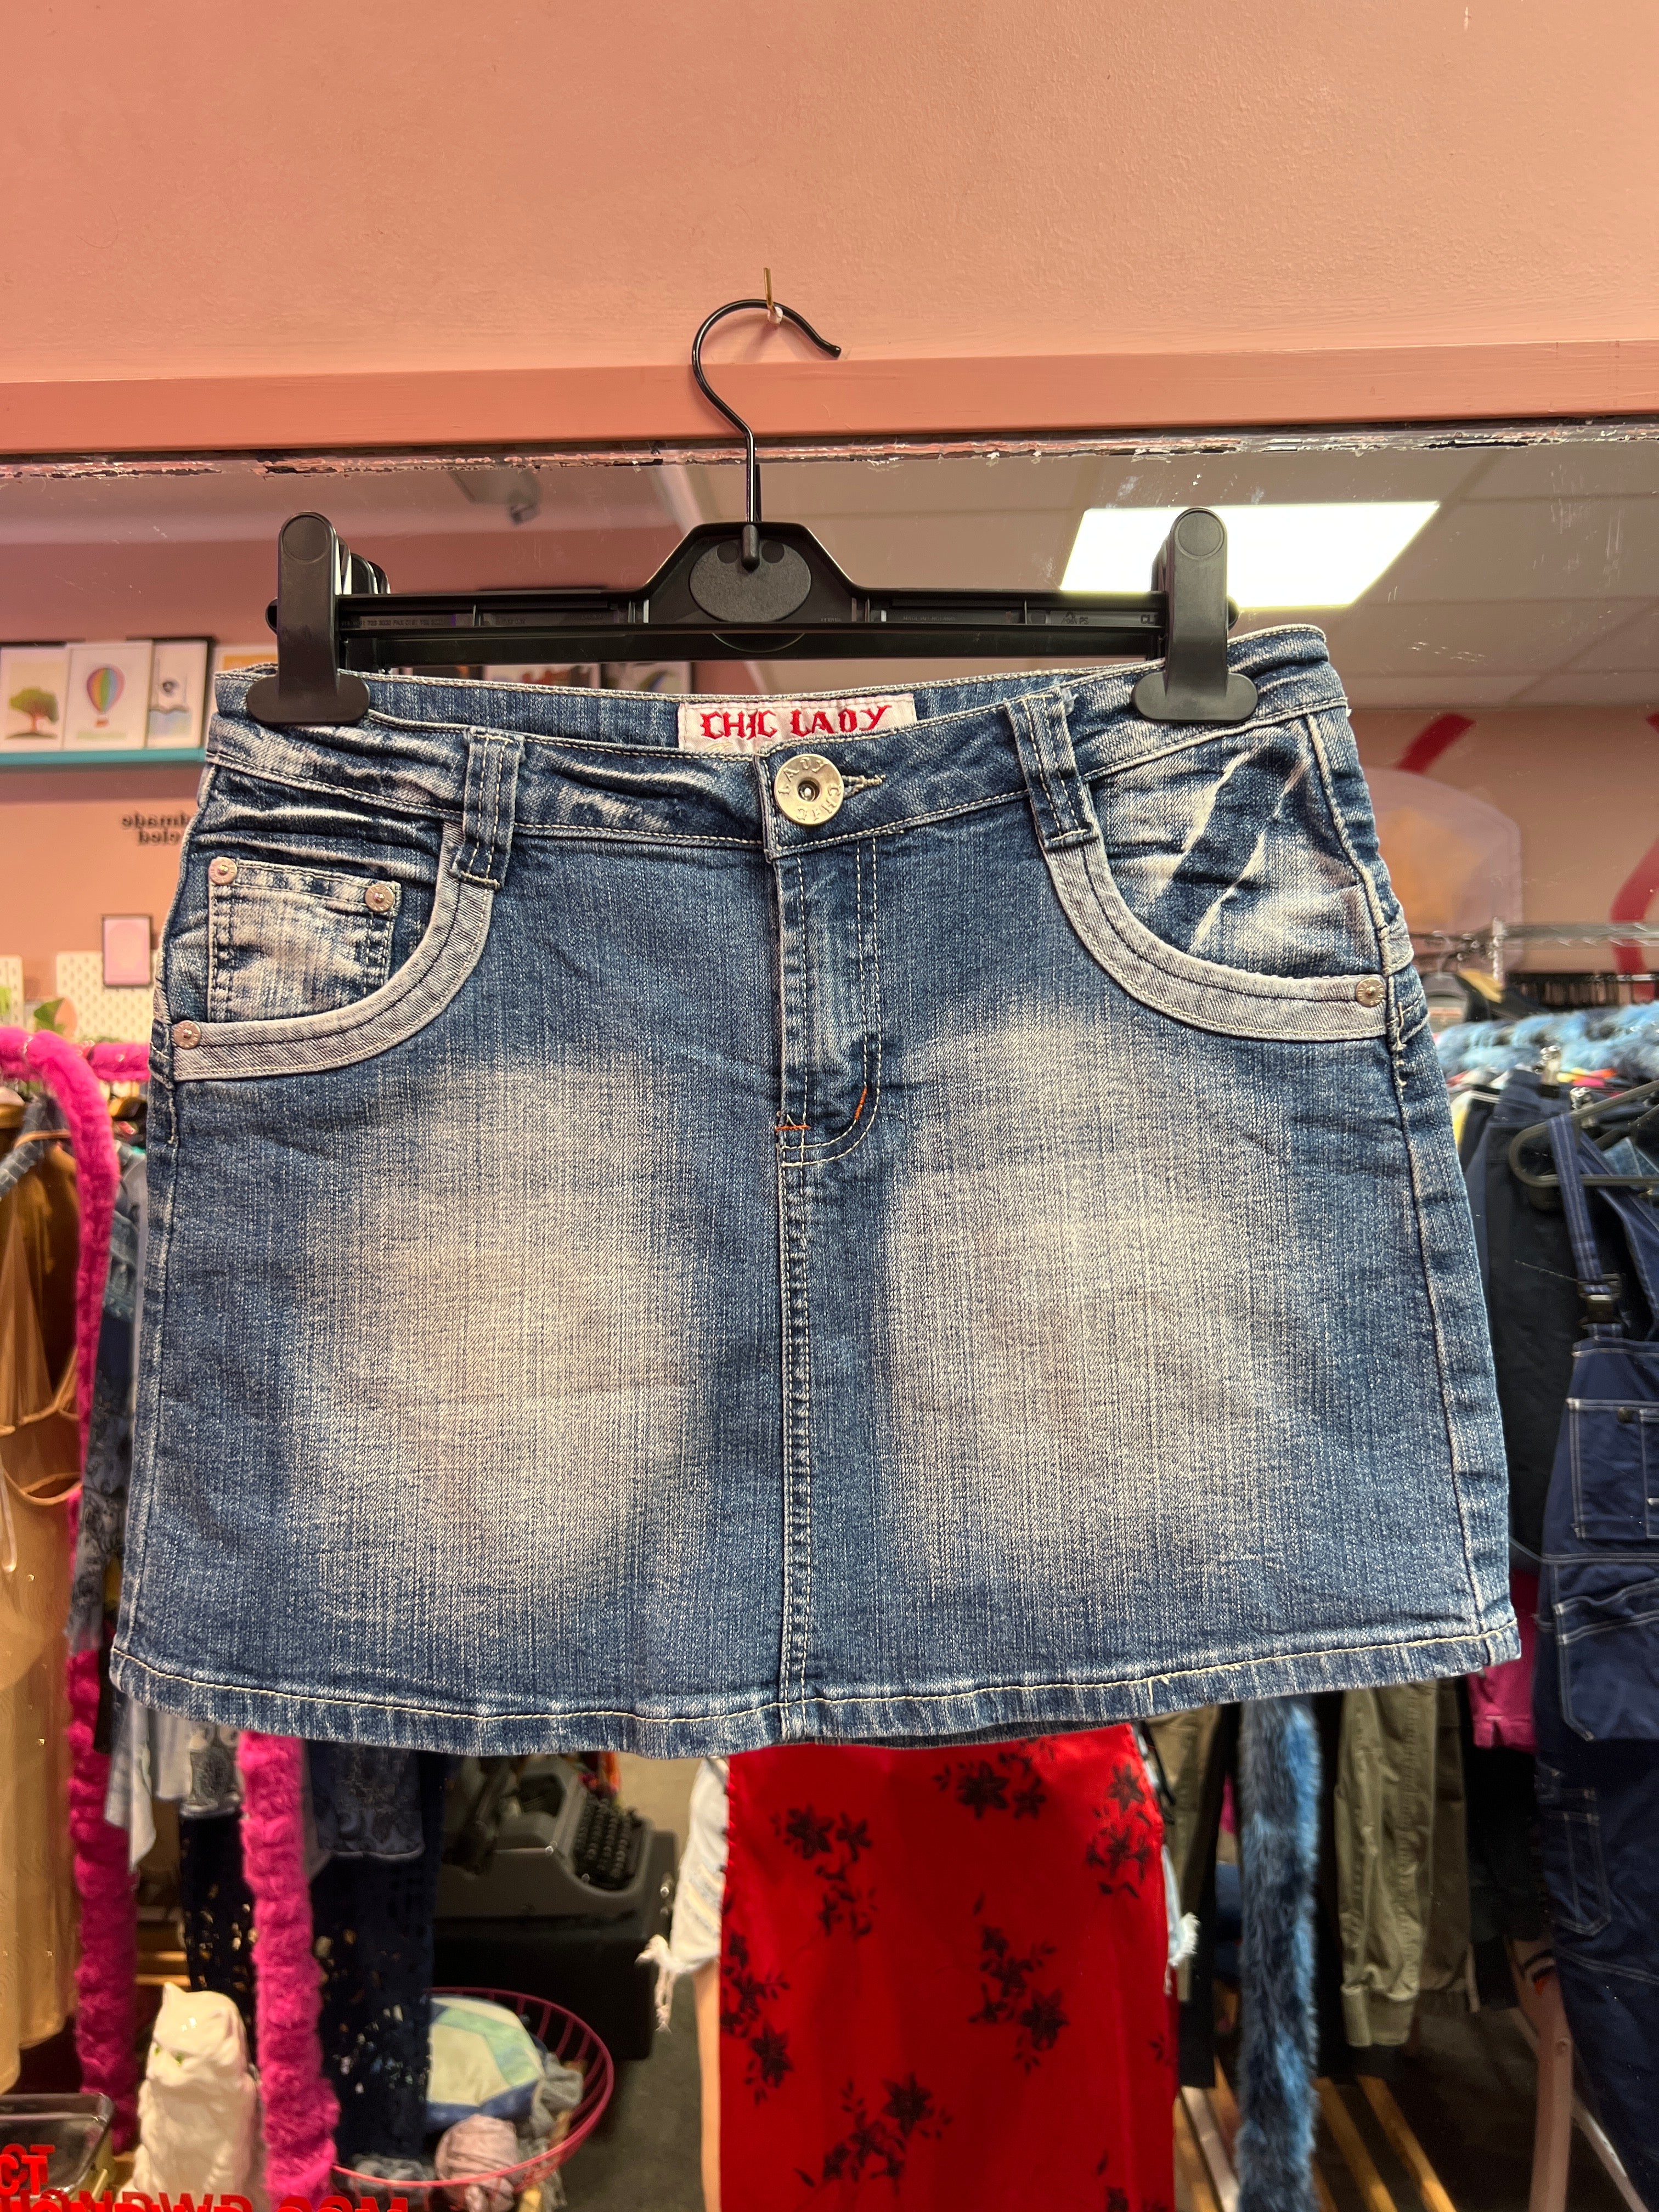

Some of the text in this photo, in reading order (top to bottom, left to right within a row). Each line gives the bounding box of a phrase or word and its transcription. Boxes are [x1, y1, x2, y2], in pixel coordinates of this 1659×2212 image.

[1079, 617, 1090, 625] PS
[699, 704, 893, 741] CHIC LADY
